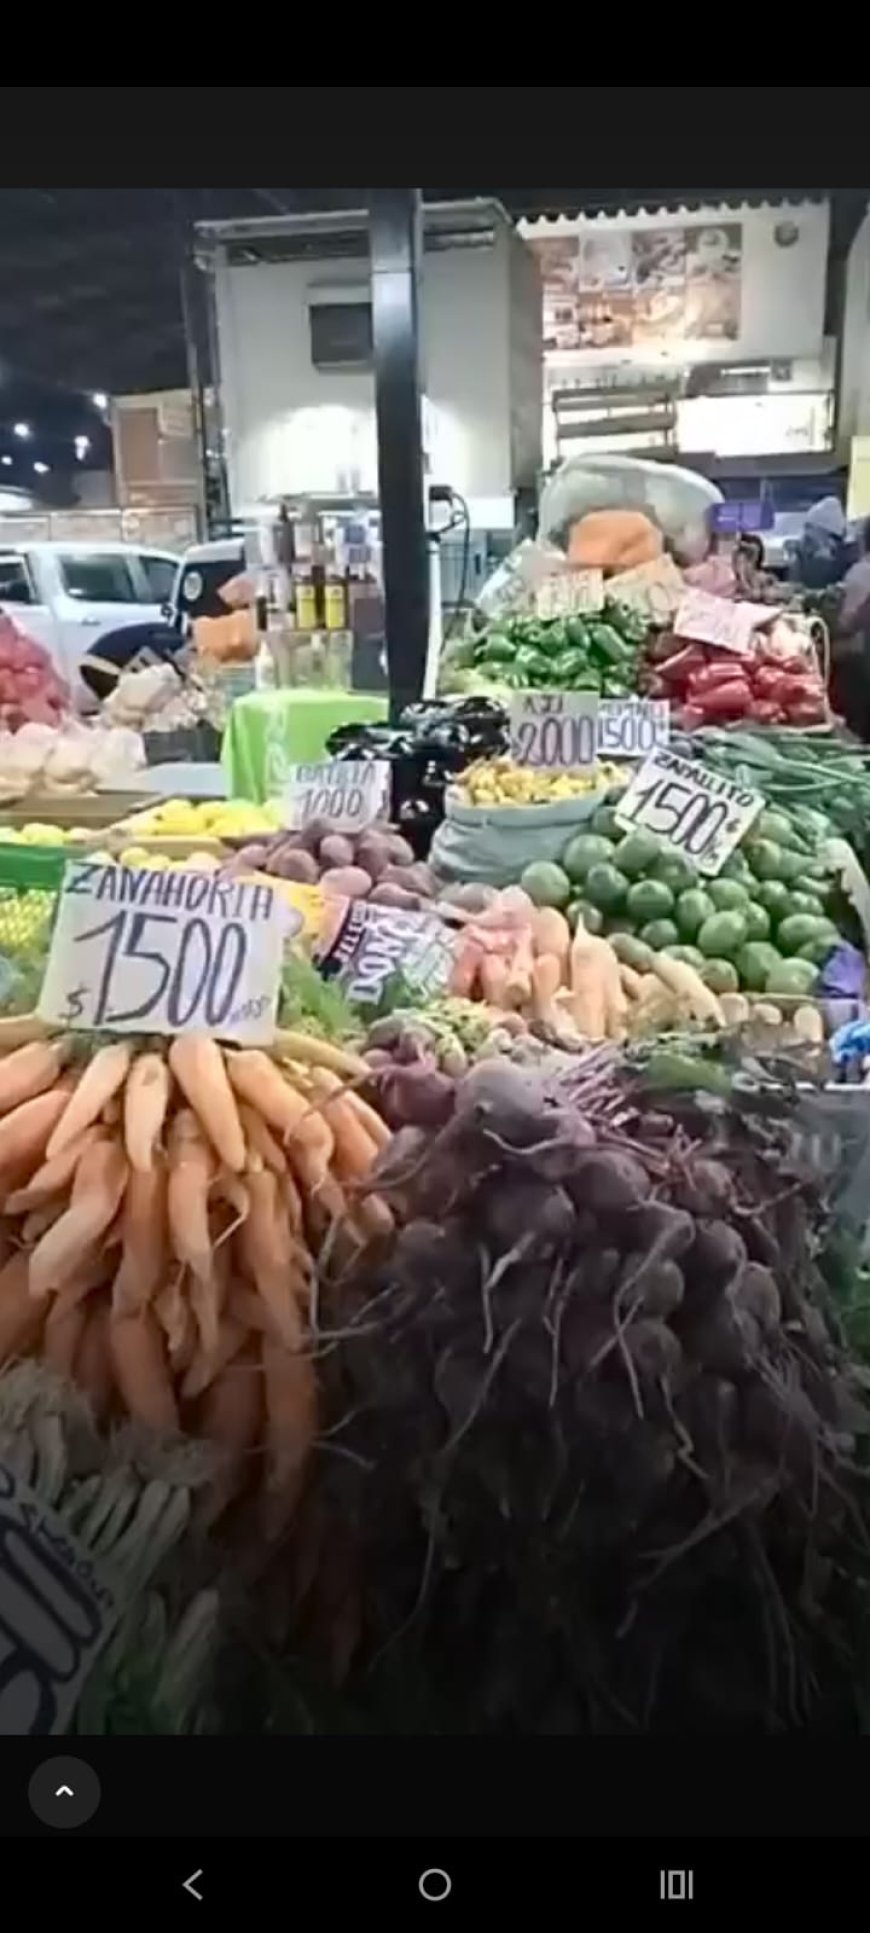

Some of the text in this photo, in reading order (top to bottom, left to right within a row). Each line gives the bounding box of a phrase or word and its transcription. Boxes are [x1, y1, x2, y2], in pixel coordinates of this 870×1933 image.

[517, 716, 596, 767] 2000
[619, 778, 728, 855] 1500
[65, 862, 273, 921] ZANAHORIA
[73, 910, 248, 1027] 1500
